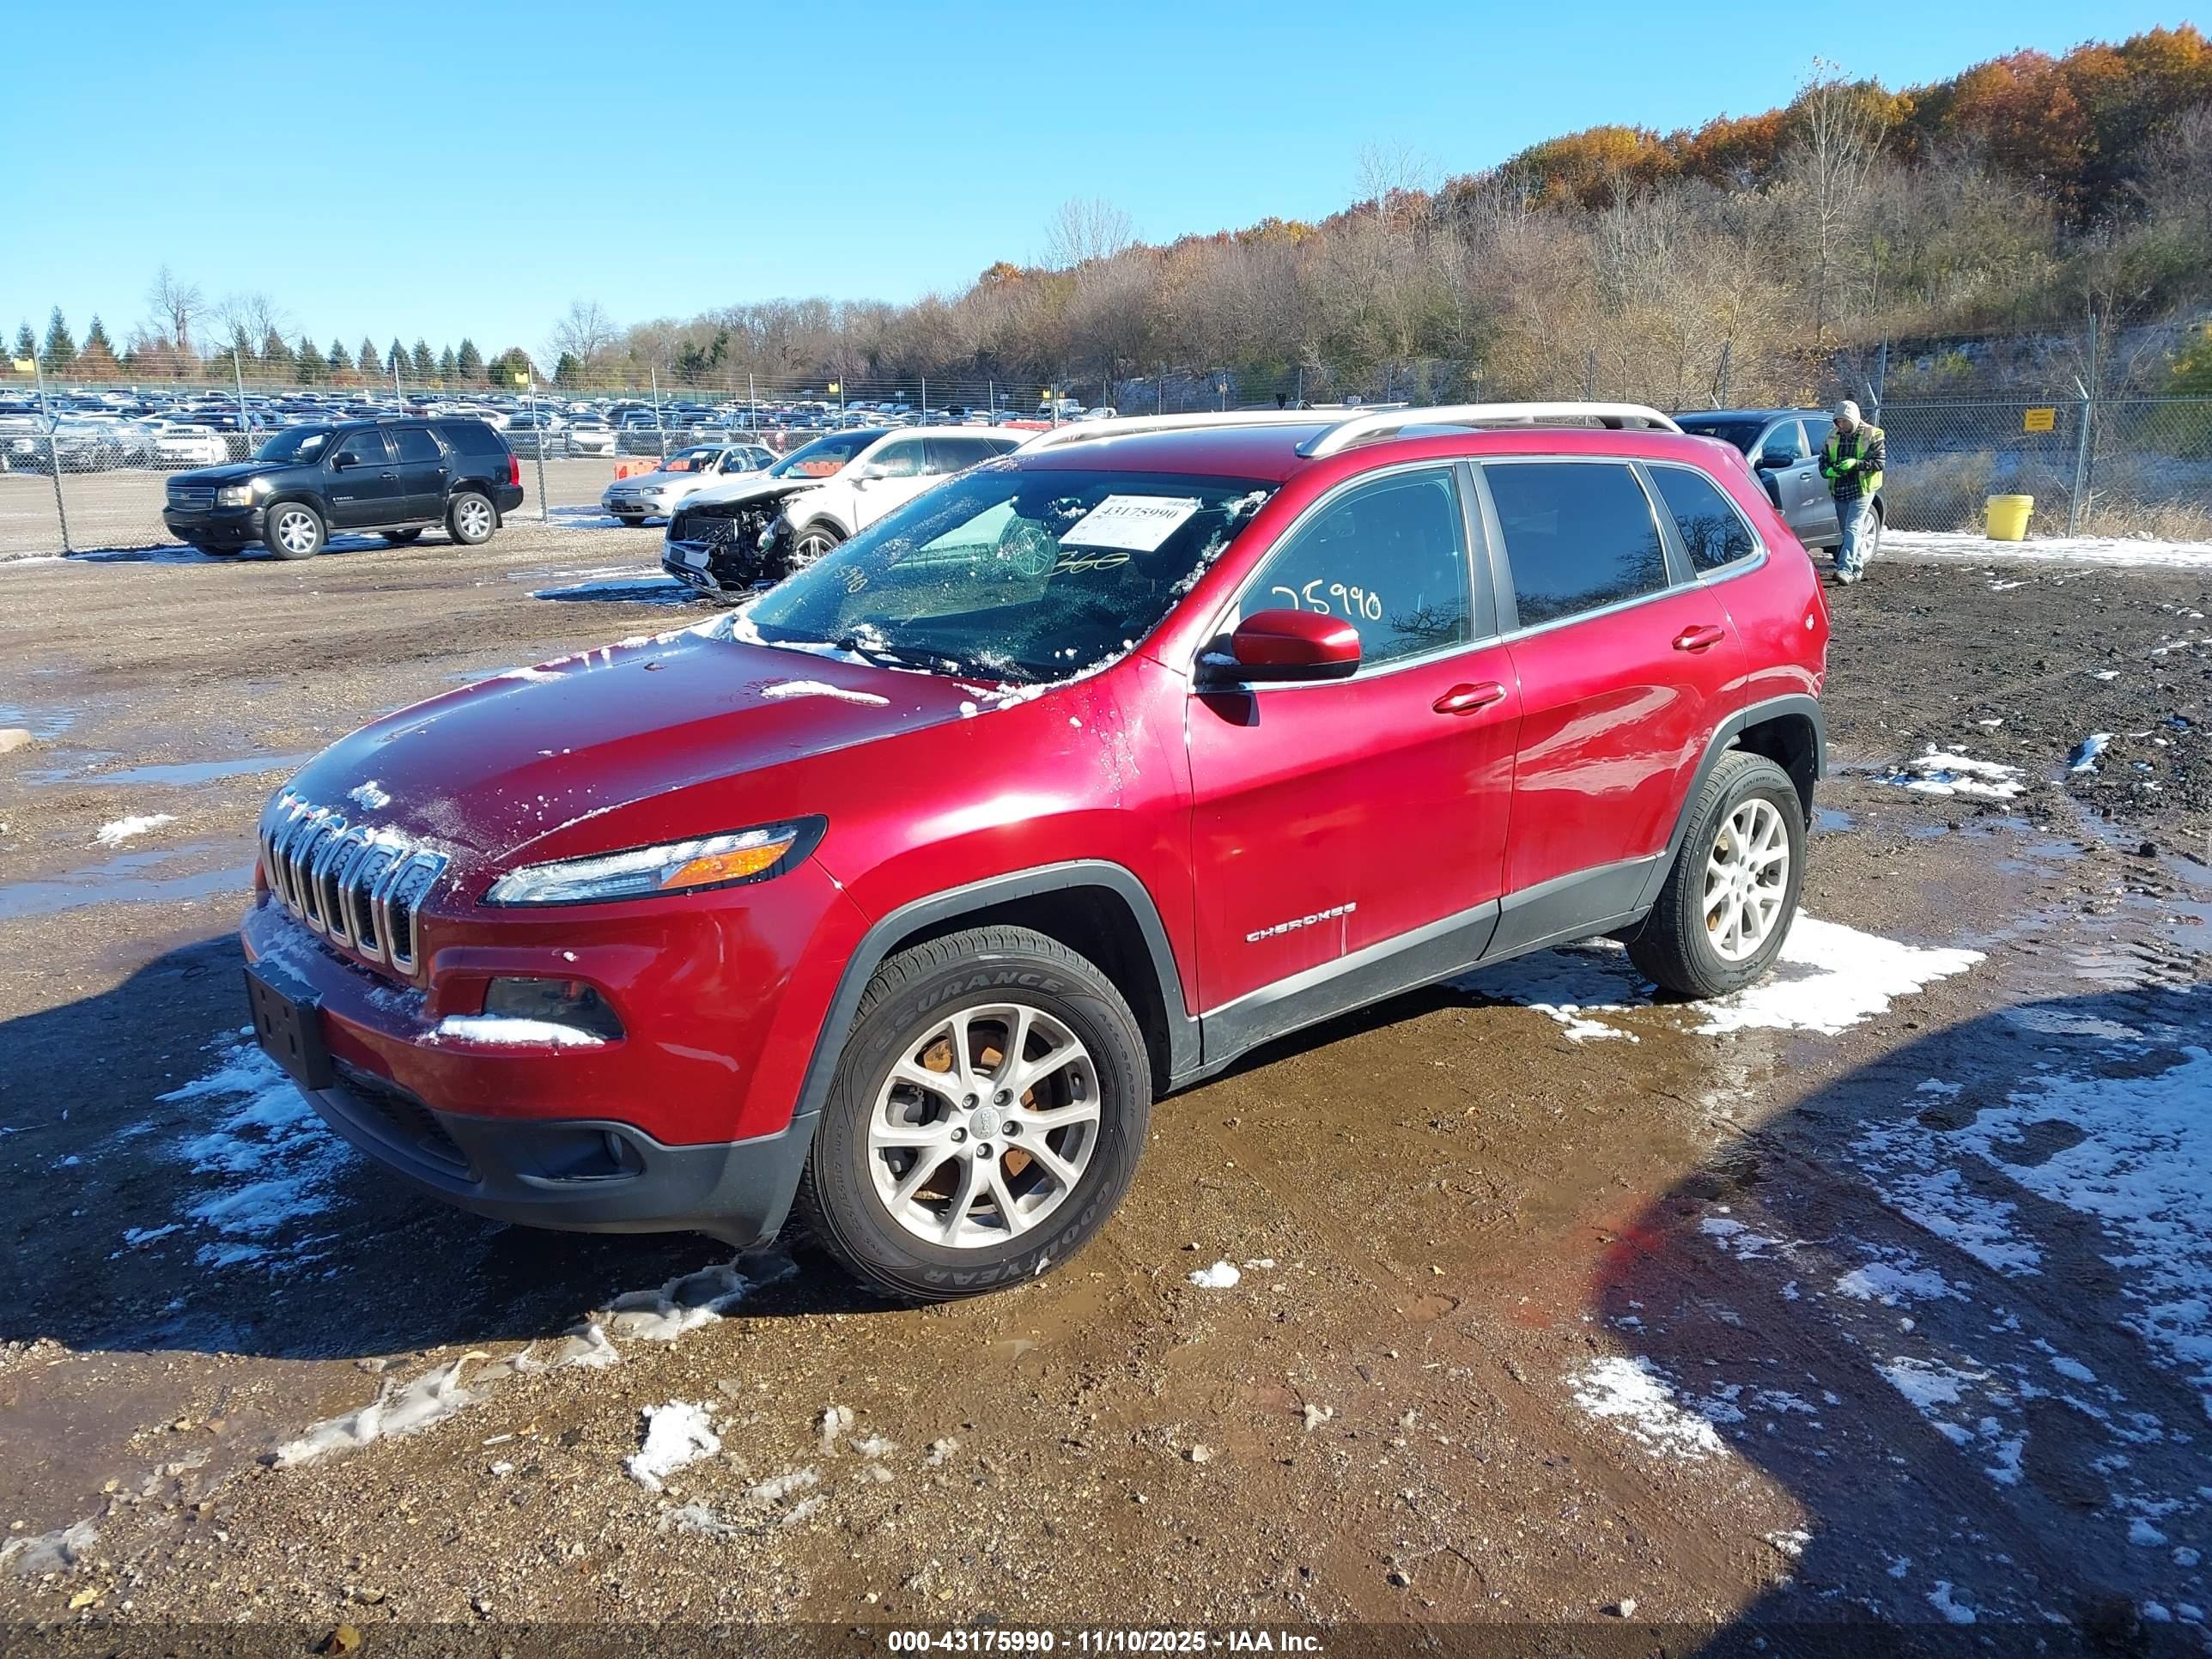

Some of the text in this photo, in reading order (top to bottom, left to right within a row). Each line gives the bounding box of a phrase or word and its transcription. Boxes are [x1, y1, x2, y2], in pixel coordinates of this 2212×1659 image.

[1101, 506, 1179, 520] 43175990
[1044, 550, 1130, 577] 360
[1272, 579, 1382, 620] 75990
[1245, 902, 1357, 943] CHEROKEE
[861, 971, 1065, 1079] ASSURANCE
